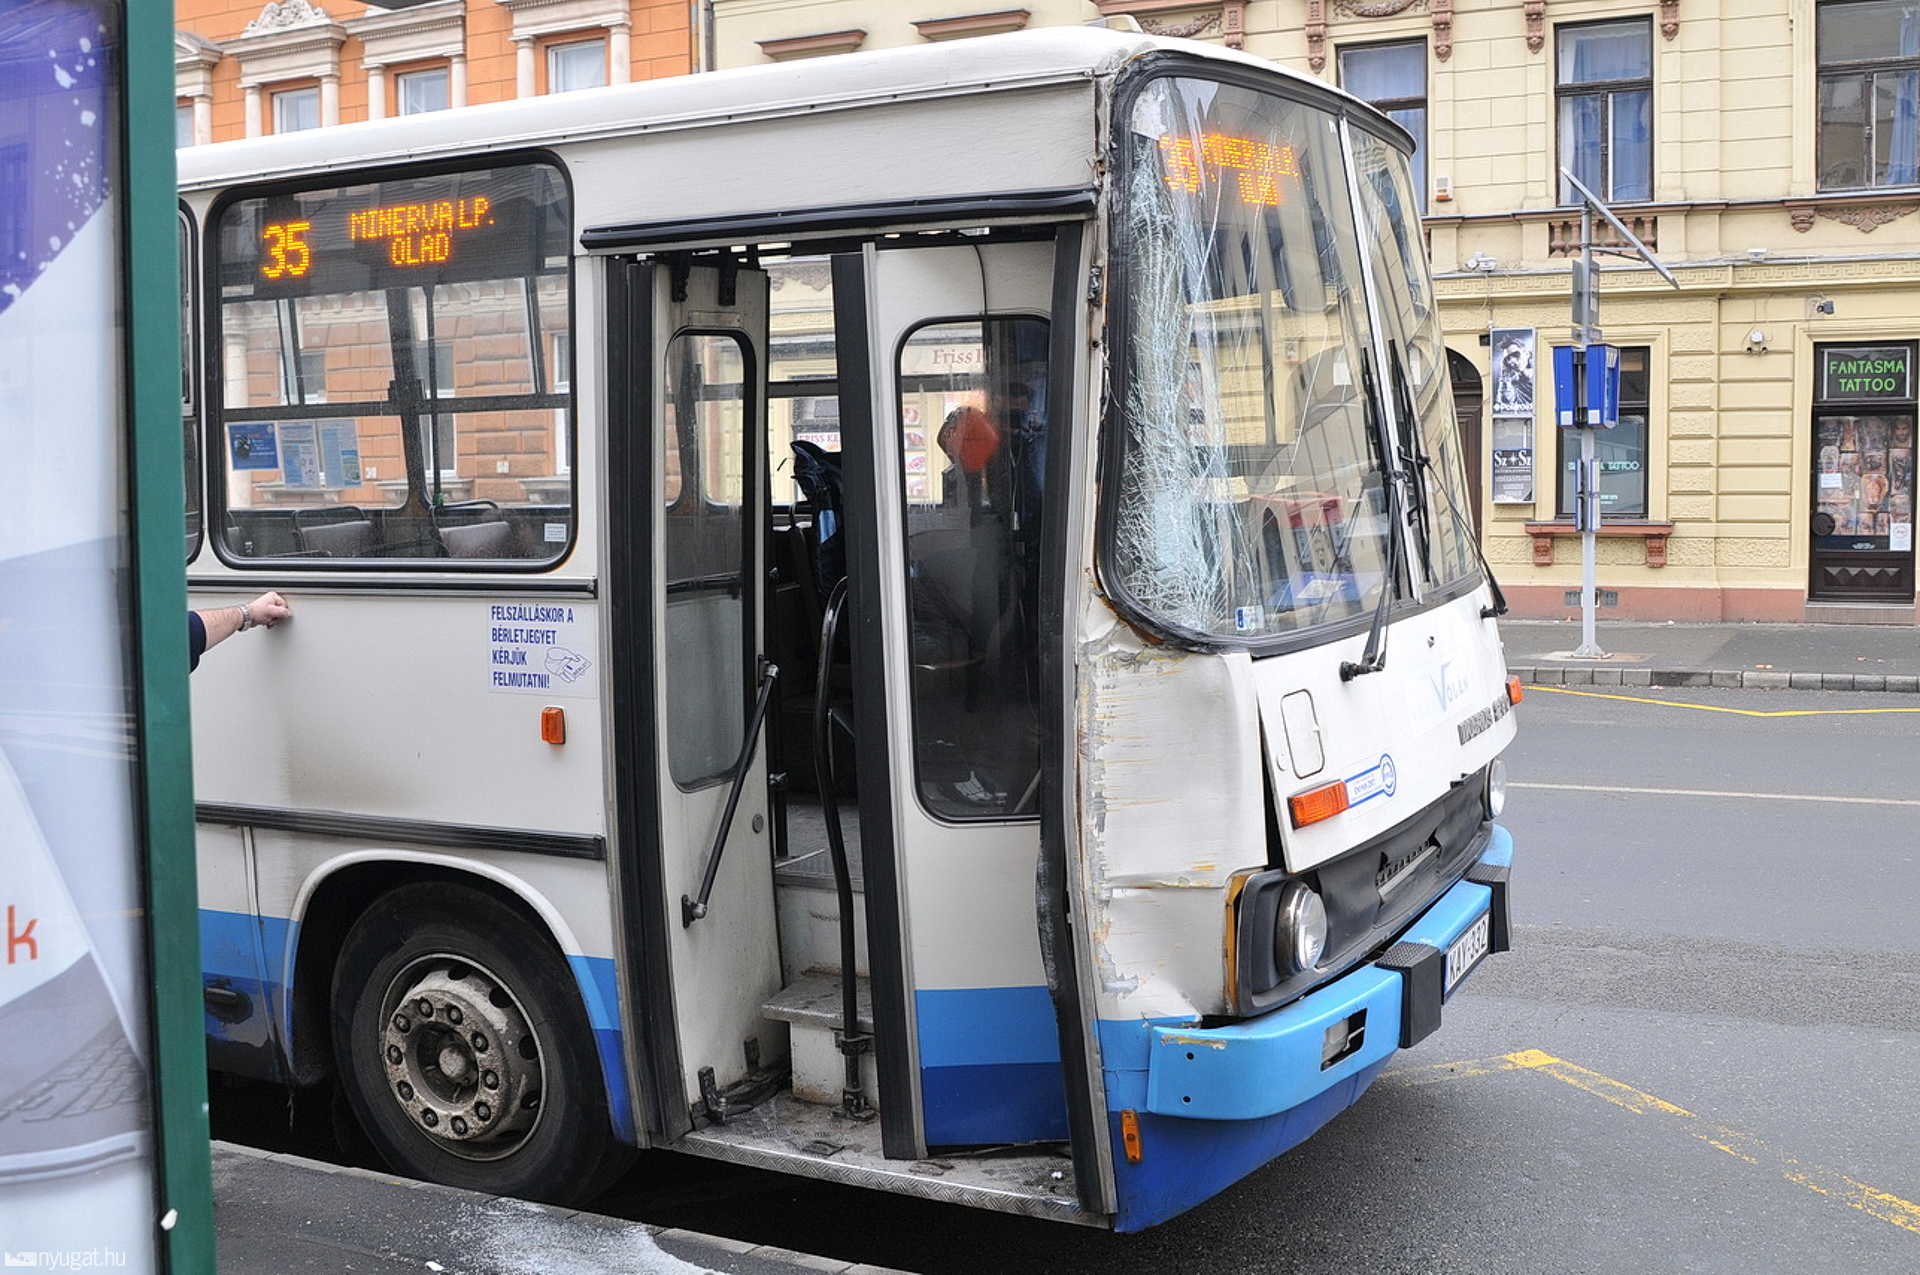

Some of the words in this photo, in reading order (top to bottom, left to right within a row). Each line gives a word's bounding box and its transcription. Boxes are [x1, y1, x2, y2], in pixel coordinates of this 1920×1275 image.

[263, 221, 311, 278] 35
[391, 232, 450, 264] OLAD
[932, 349, 973, 365] Friss
[1830, 359, 1905, 375] FANTASMA
[1839, 376, 1896, 392] TATTOO
[491, 603, 564, 623] FELSZÁLLÁSKOR
[566, 607, 574, 624] A
[491, 624, 557, 645] BÉRLETJEGYET
[491, 647, 528, 666] KÉRJÜK
[493, 671, 550, 689] FELMUTATNI!
[7, 904, 38, 966] k
